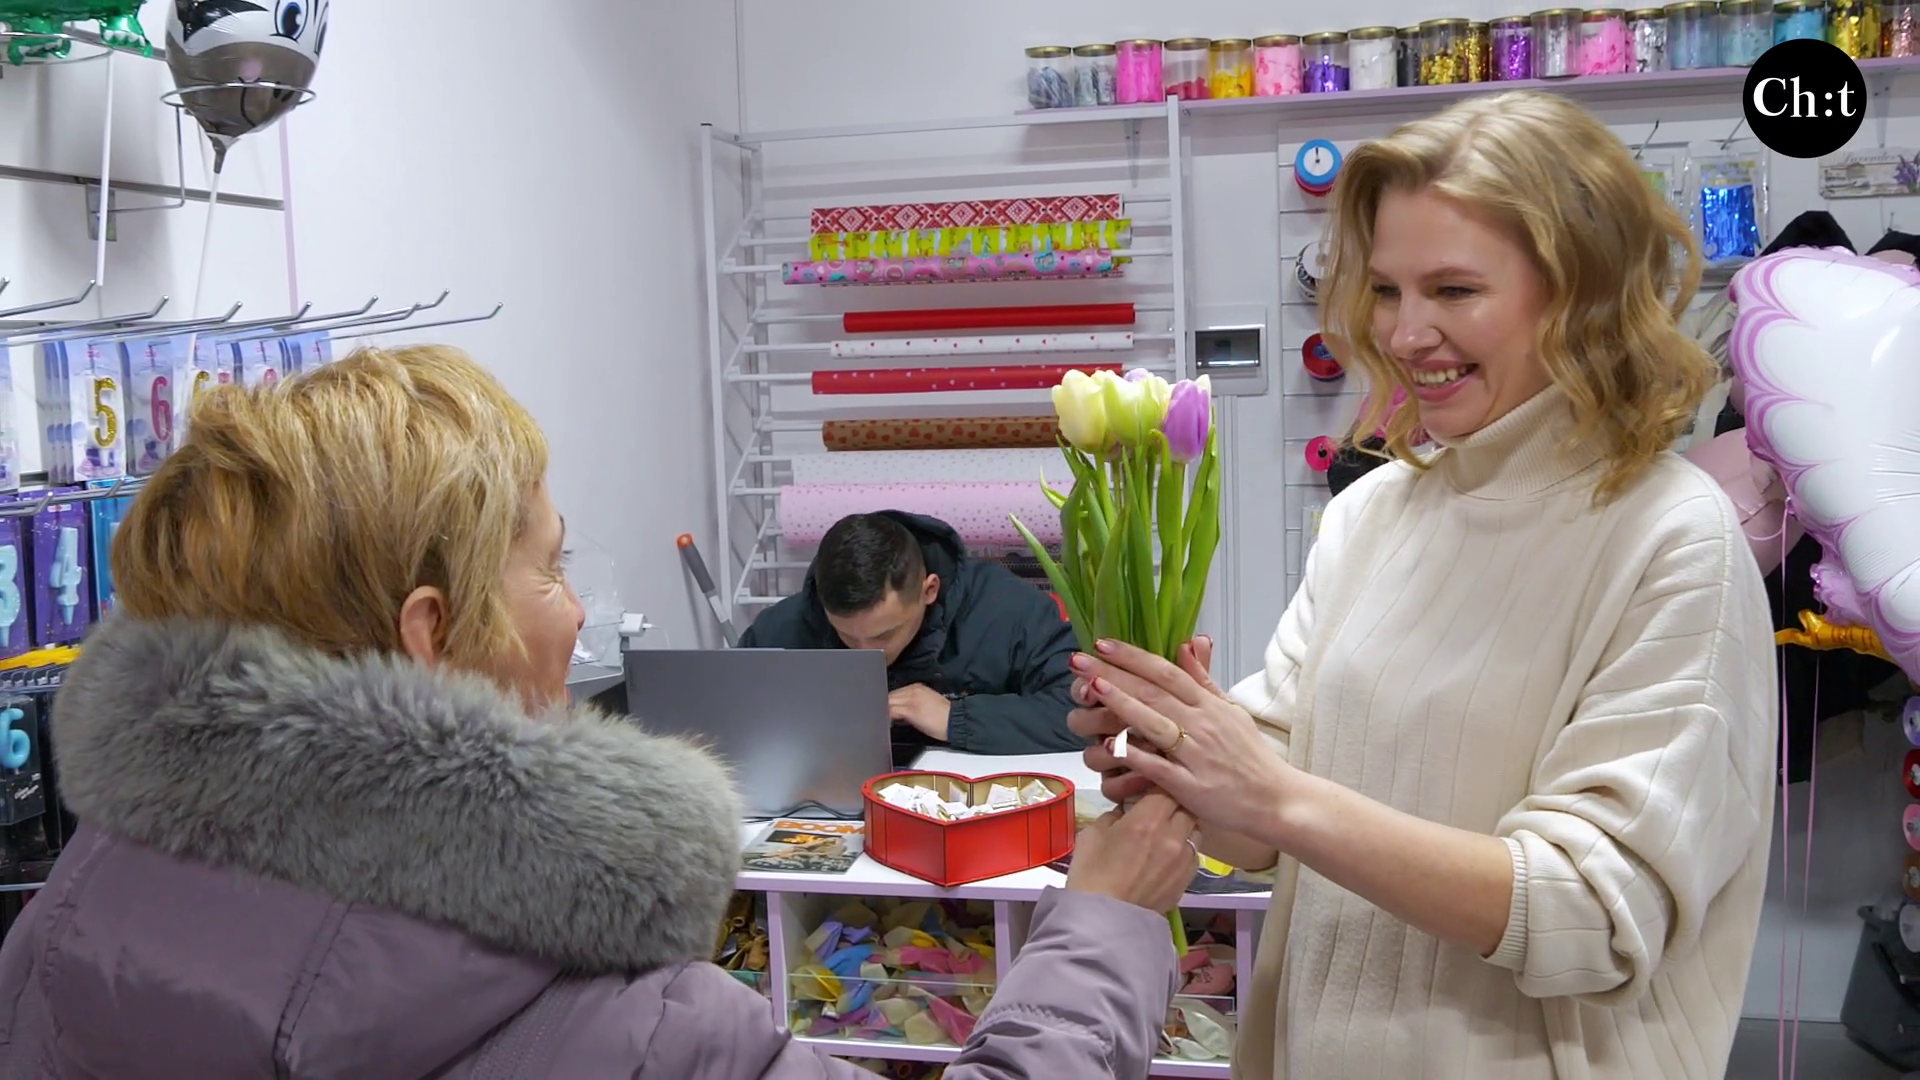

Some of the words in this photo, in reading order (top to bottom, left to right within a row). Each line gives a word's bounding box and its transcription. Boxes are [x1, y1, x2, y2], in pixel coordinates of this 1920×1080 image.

[94, 377, 117, 448] 5
[151, 376, 172, 441] 6
[49, 527, 82, 606] 4
[0, 707, 31, 769] 6
